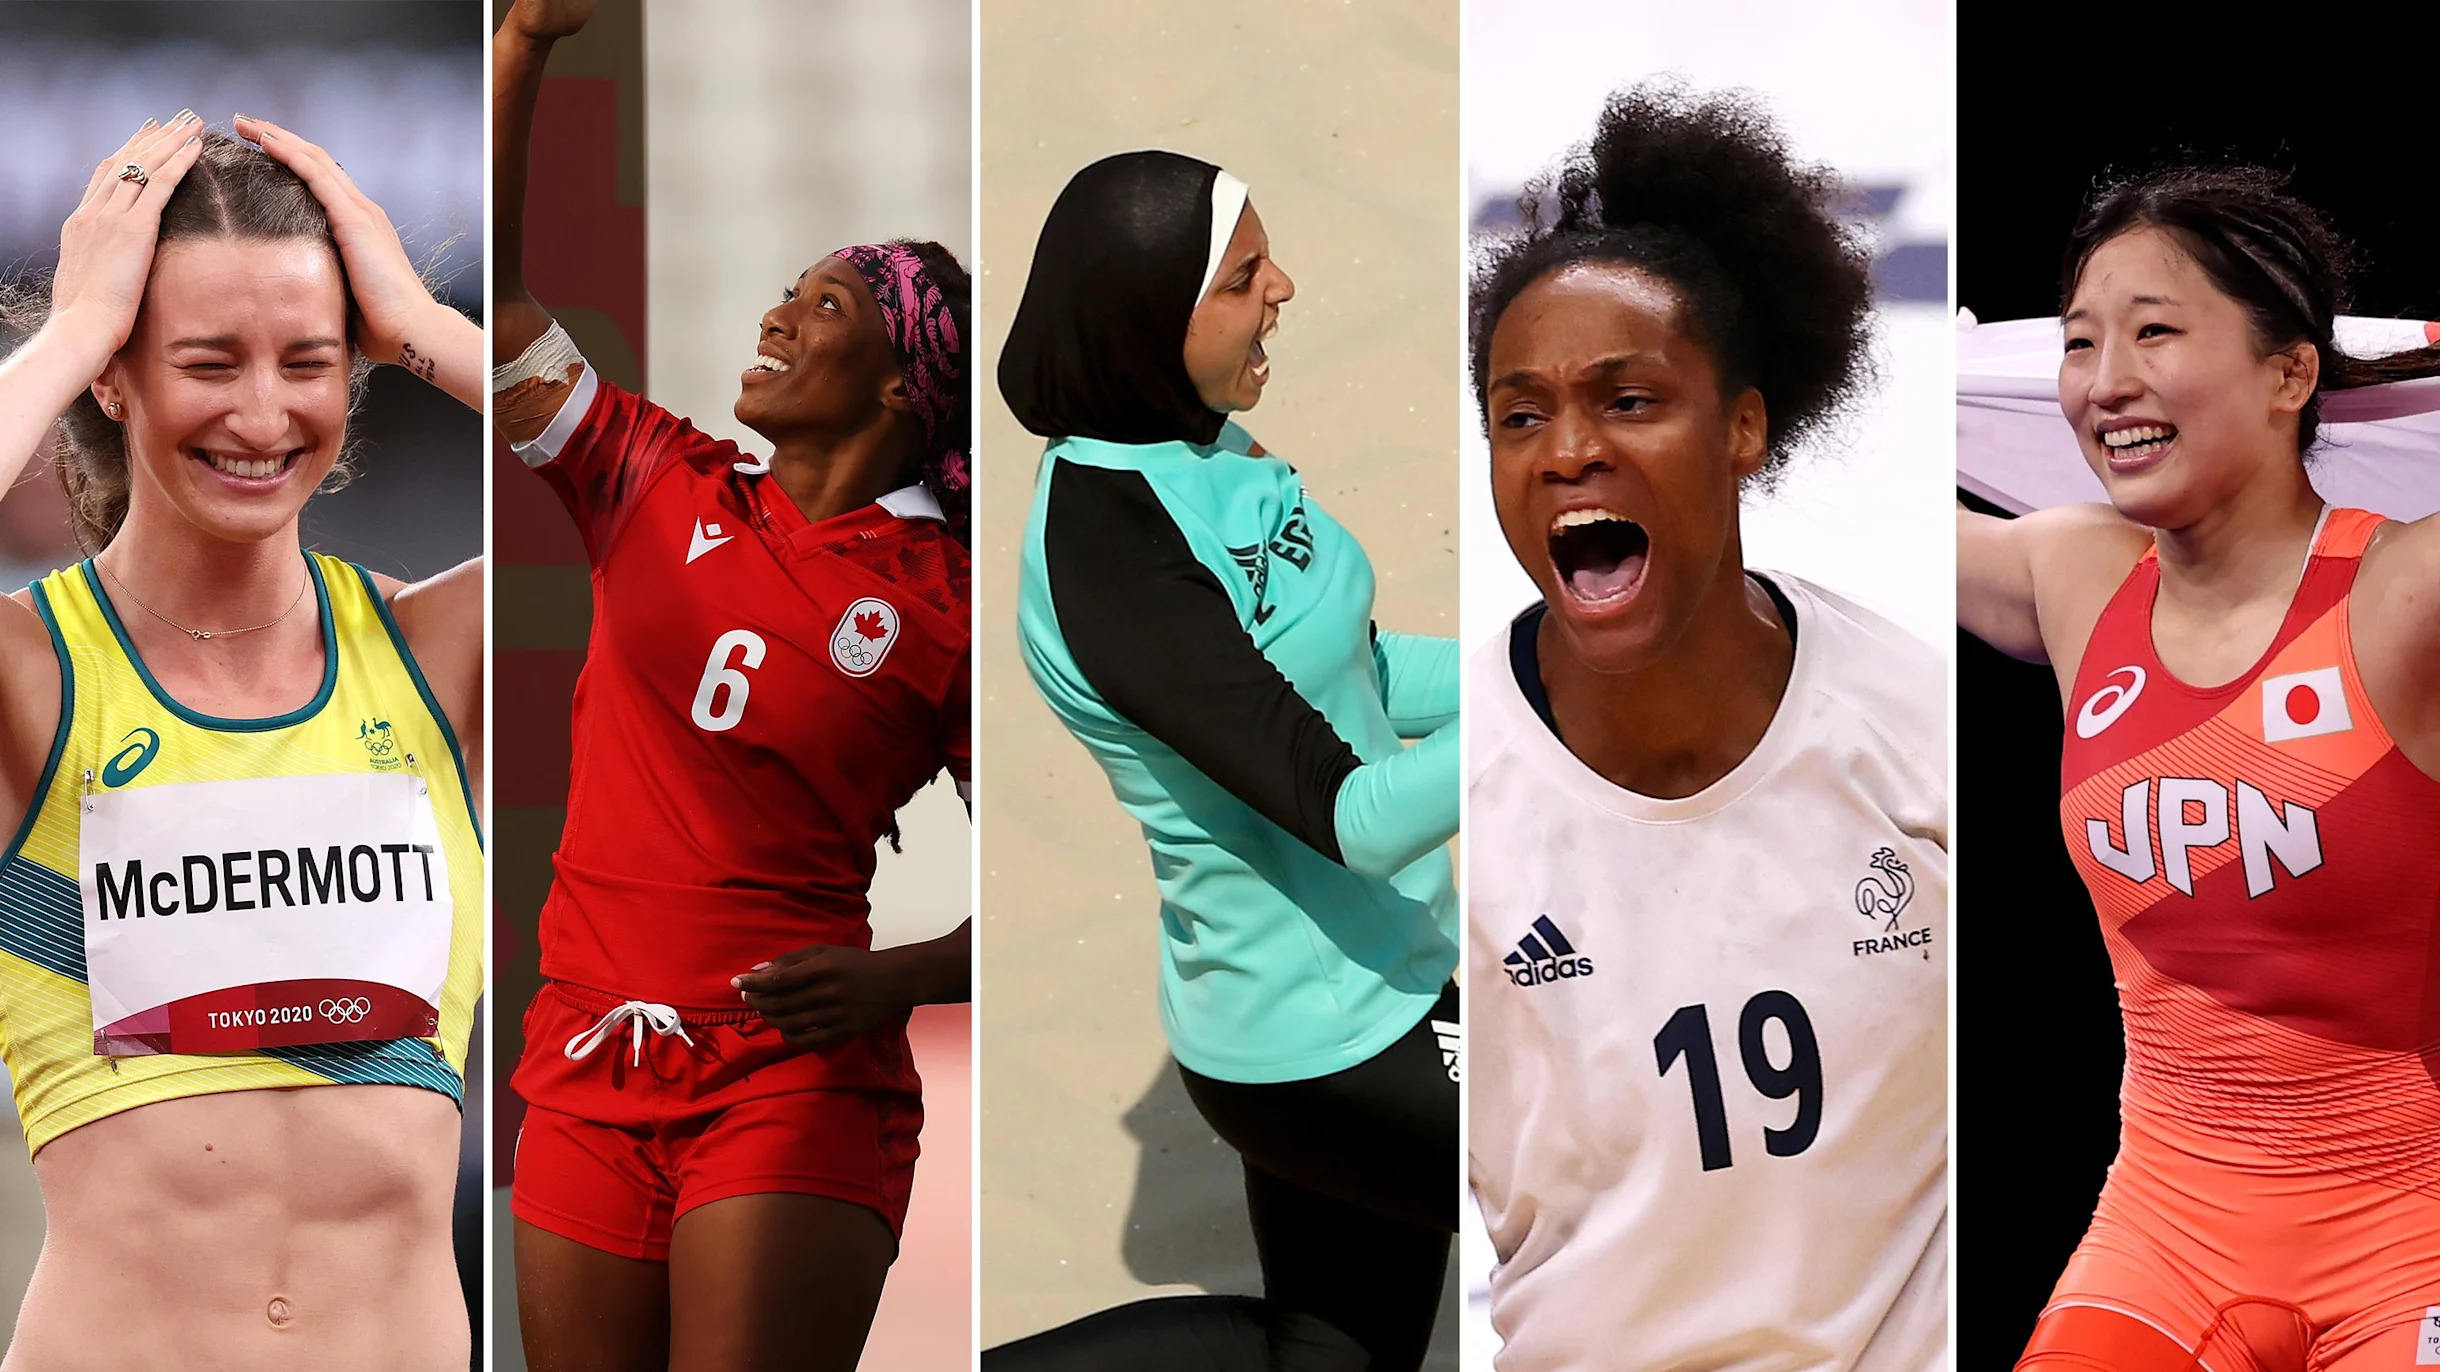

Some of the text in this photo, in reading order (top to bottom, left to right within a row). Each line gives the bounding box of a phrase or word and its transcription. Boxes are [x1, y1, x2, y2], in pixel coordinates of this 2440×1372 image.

[691, 629, 767, 732] 6
[370, 756, 400, 765] AUSTRALIA
[370, 762, 402, 771] TOKYO 2020
[2085, 776, 2325, 900] JPN
[95, 844, 435, 921] McDERMOTT
[1853, 927, 1933, 956] FRANCE
[208, 1005, 313, 1029] TOKYO 2020
[1653, 989, 1824, 1172] 19
